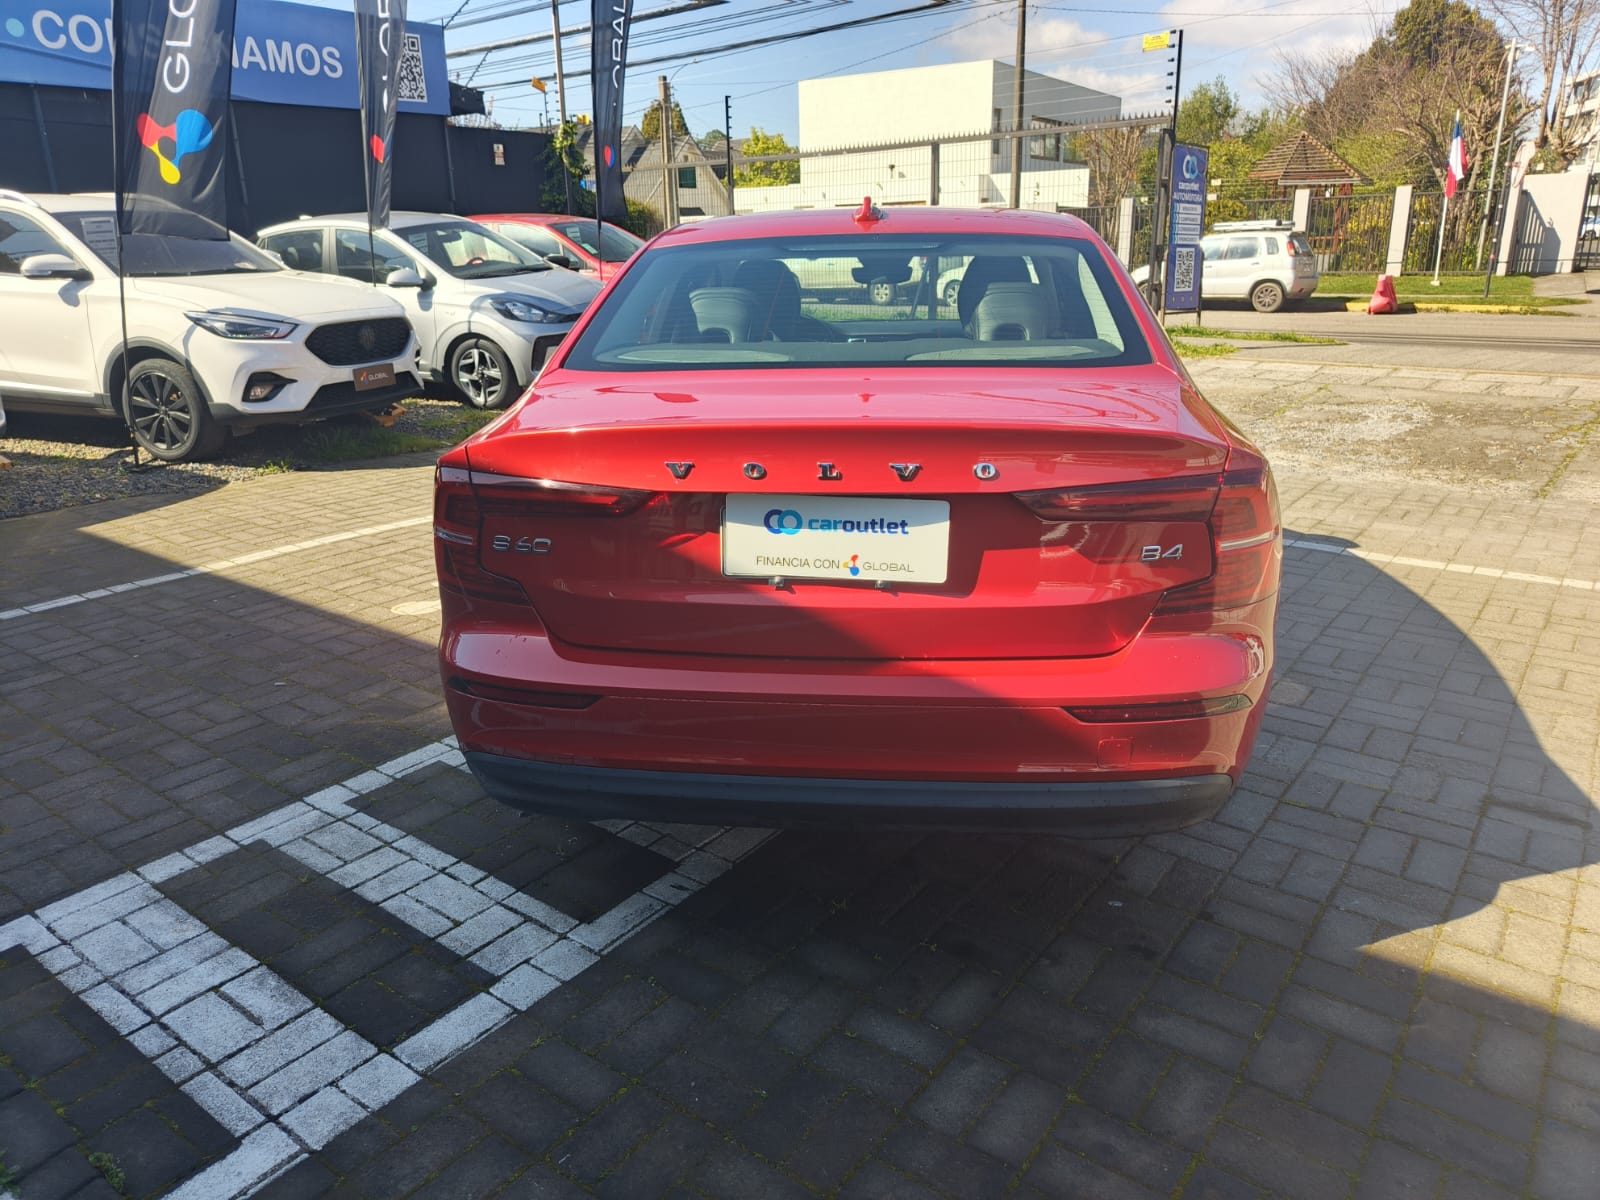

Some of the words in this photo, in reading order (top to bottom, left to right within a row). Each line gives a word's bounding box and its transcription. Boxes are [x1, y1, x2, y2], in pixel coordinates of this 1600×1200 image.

[664, 461, 1000, 481] VOLVO
[808, 516, 909, 535] caroutlet
[492, 535, 552, 553] S60
[1140, 543, 1183, 561] B4
[756, 555, 811, 569] FINANCIA
[813, 556, 840, 569] CON
[862, 561, 915, 573] GLOBAL
